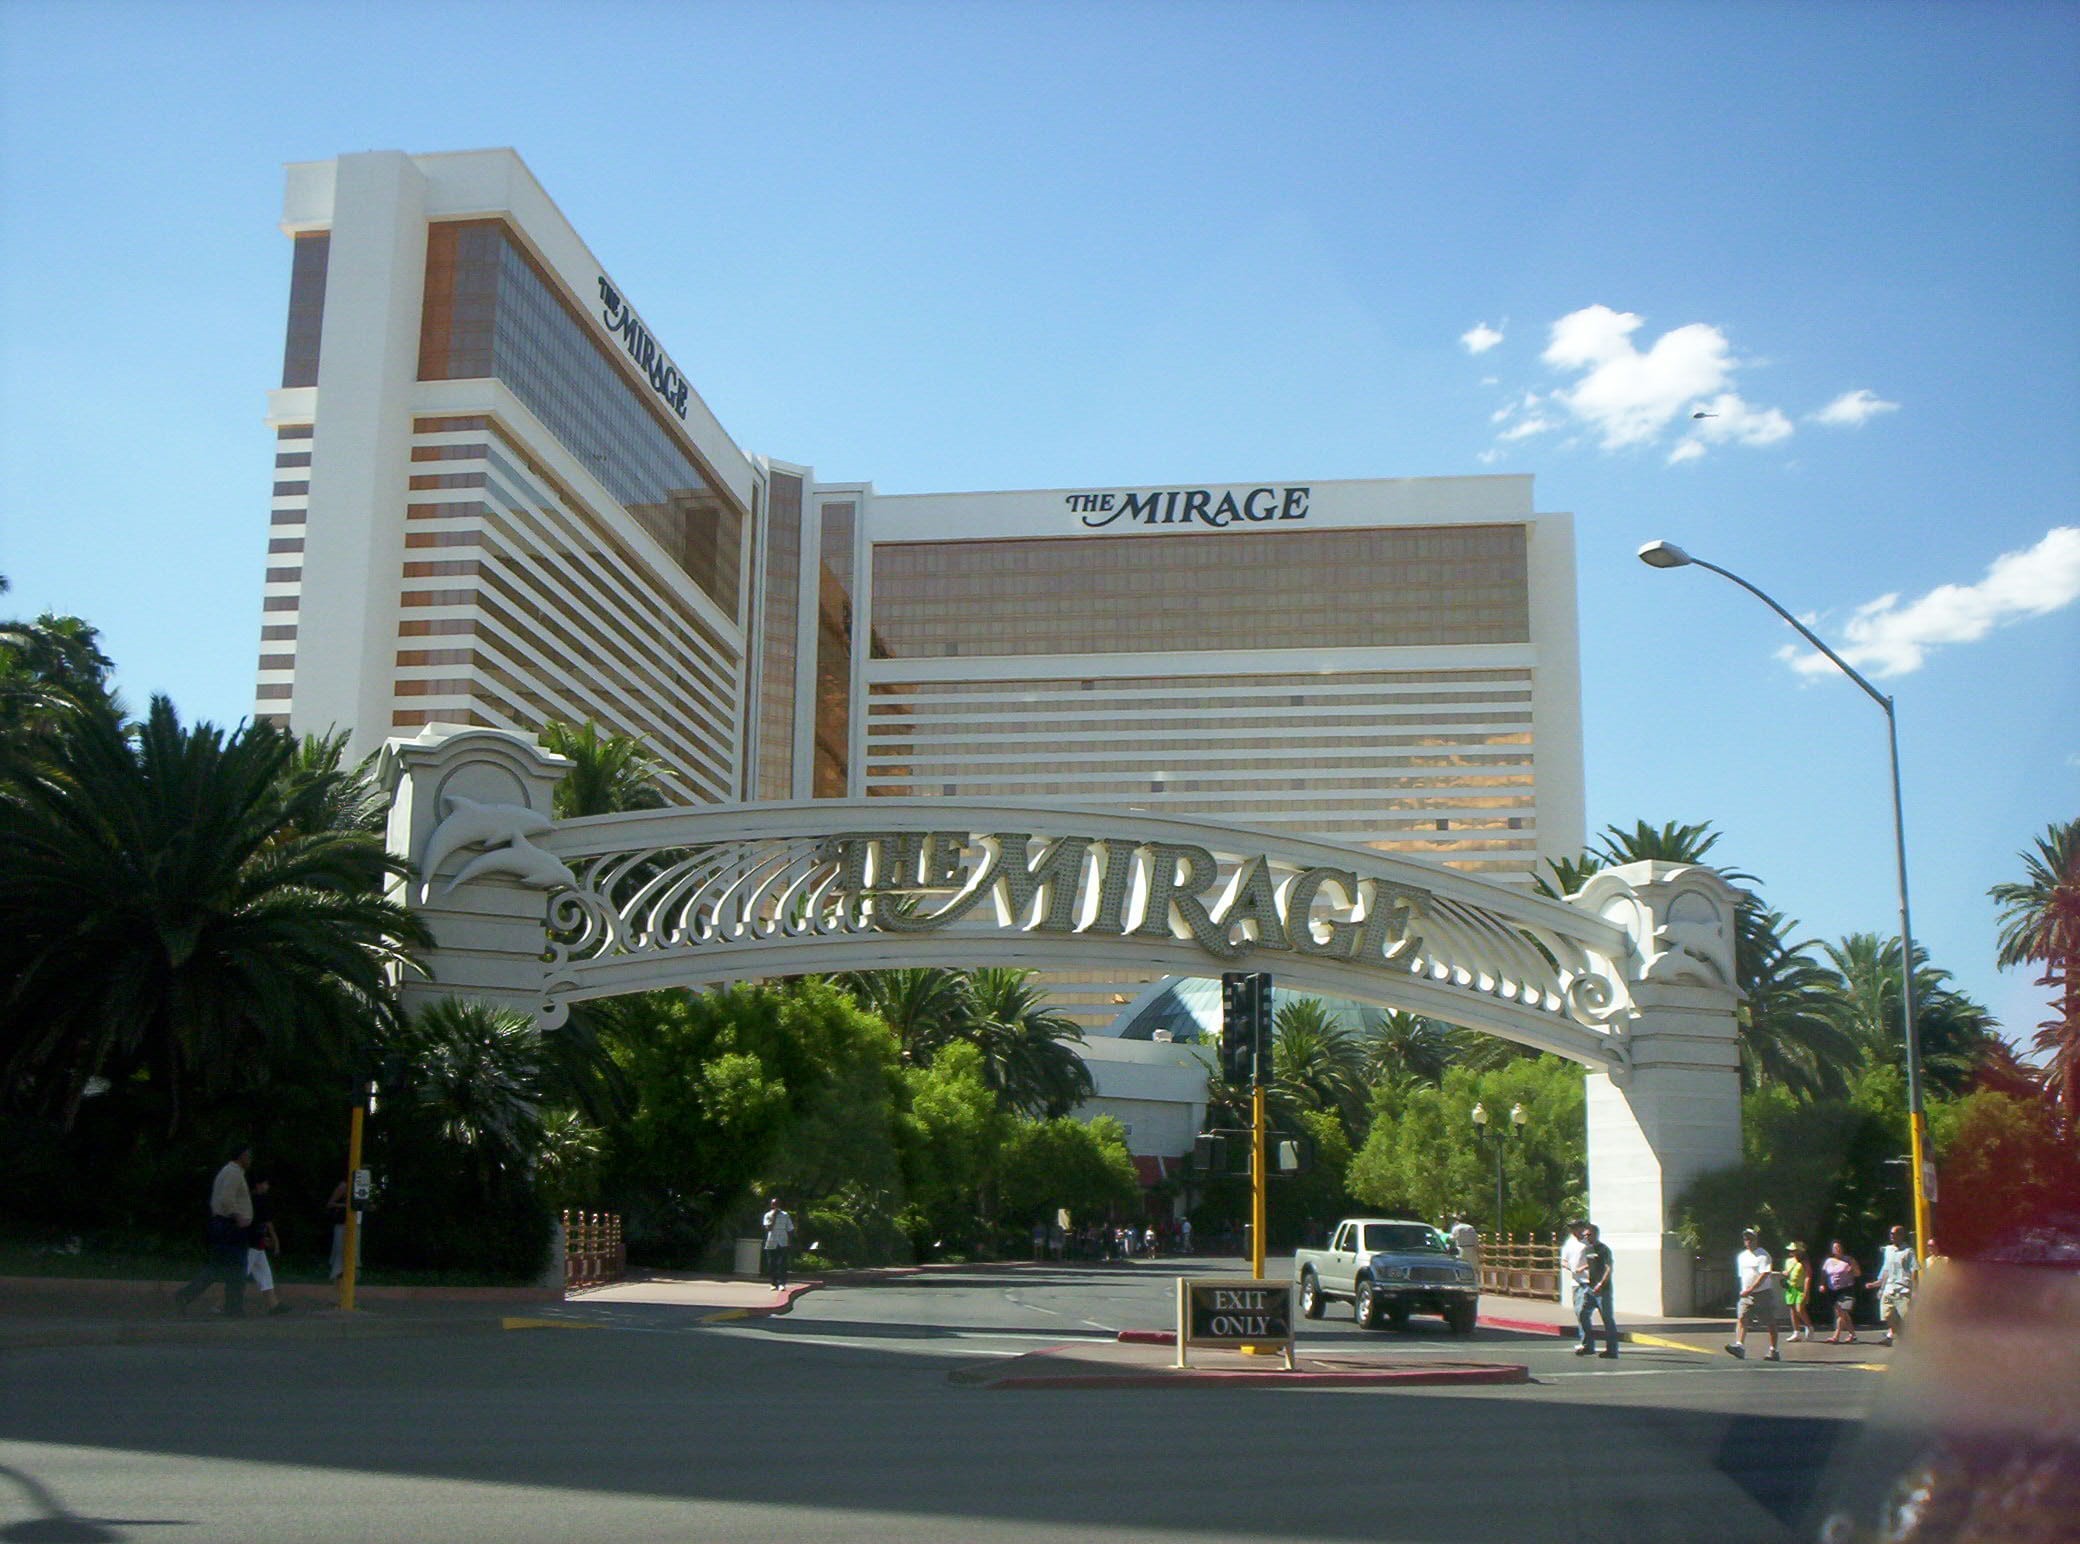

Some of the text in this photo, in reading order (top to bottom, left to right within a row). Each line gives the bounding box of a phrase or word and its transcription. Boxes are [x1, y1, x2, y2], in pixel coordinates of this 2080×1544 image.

[603, 305, 689, 420] MIRAGE
[1065, 487, 1310, 528] THE MIRAGE
[820, 831, 1433, 974] THE MIRAGE
[1215, 1290, 1268, 1310] EXIT
[1212, 1316, 1270, 1335] ONLY
